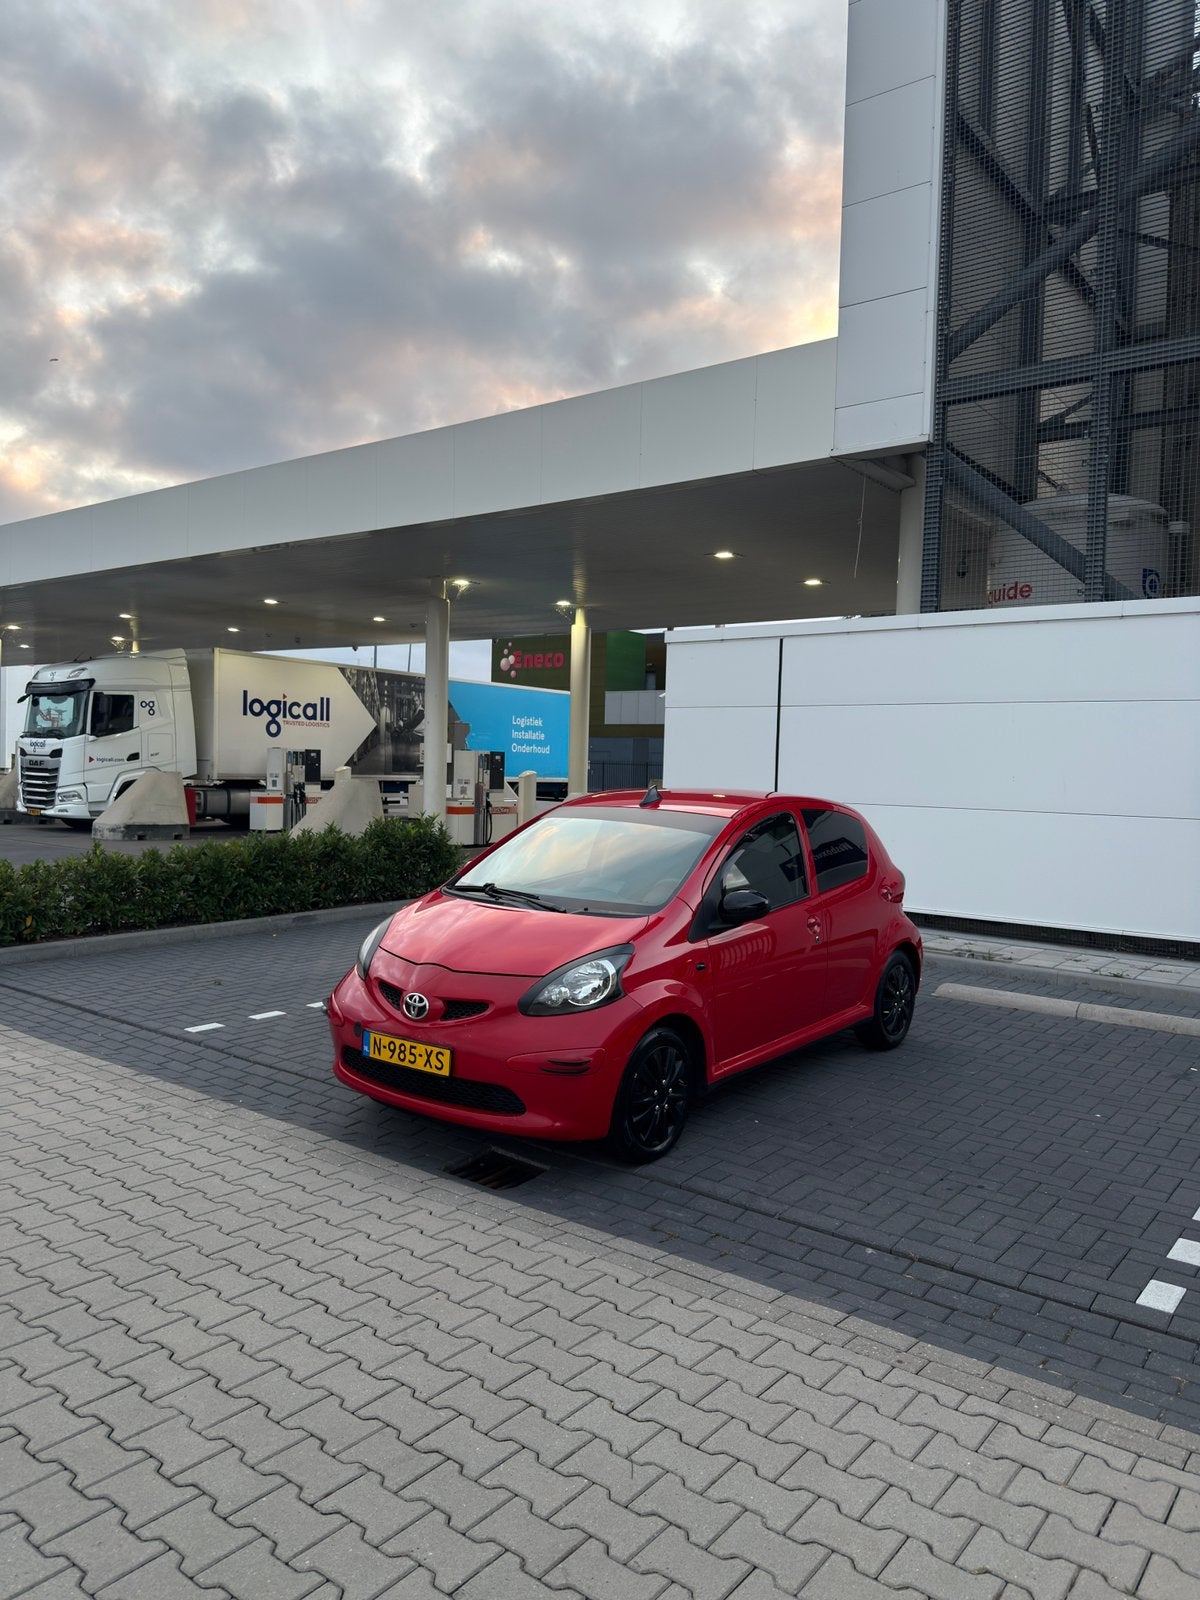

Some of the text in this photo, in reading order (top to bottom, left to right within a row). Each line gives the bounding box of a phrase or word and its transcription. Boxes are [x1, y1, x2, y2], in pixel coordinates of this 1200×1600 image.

[513, 651, 565, 668] Eneco
[243, 690, 330, 737] logicall
[512, 715, 543, 728] Logistiek
[511, 729, 546, 741] Installatie
[511, 743, 551, 755] Onderhoud
[373, 1036, 445, 1071] N-985-XS
